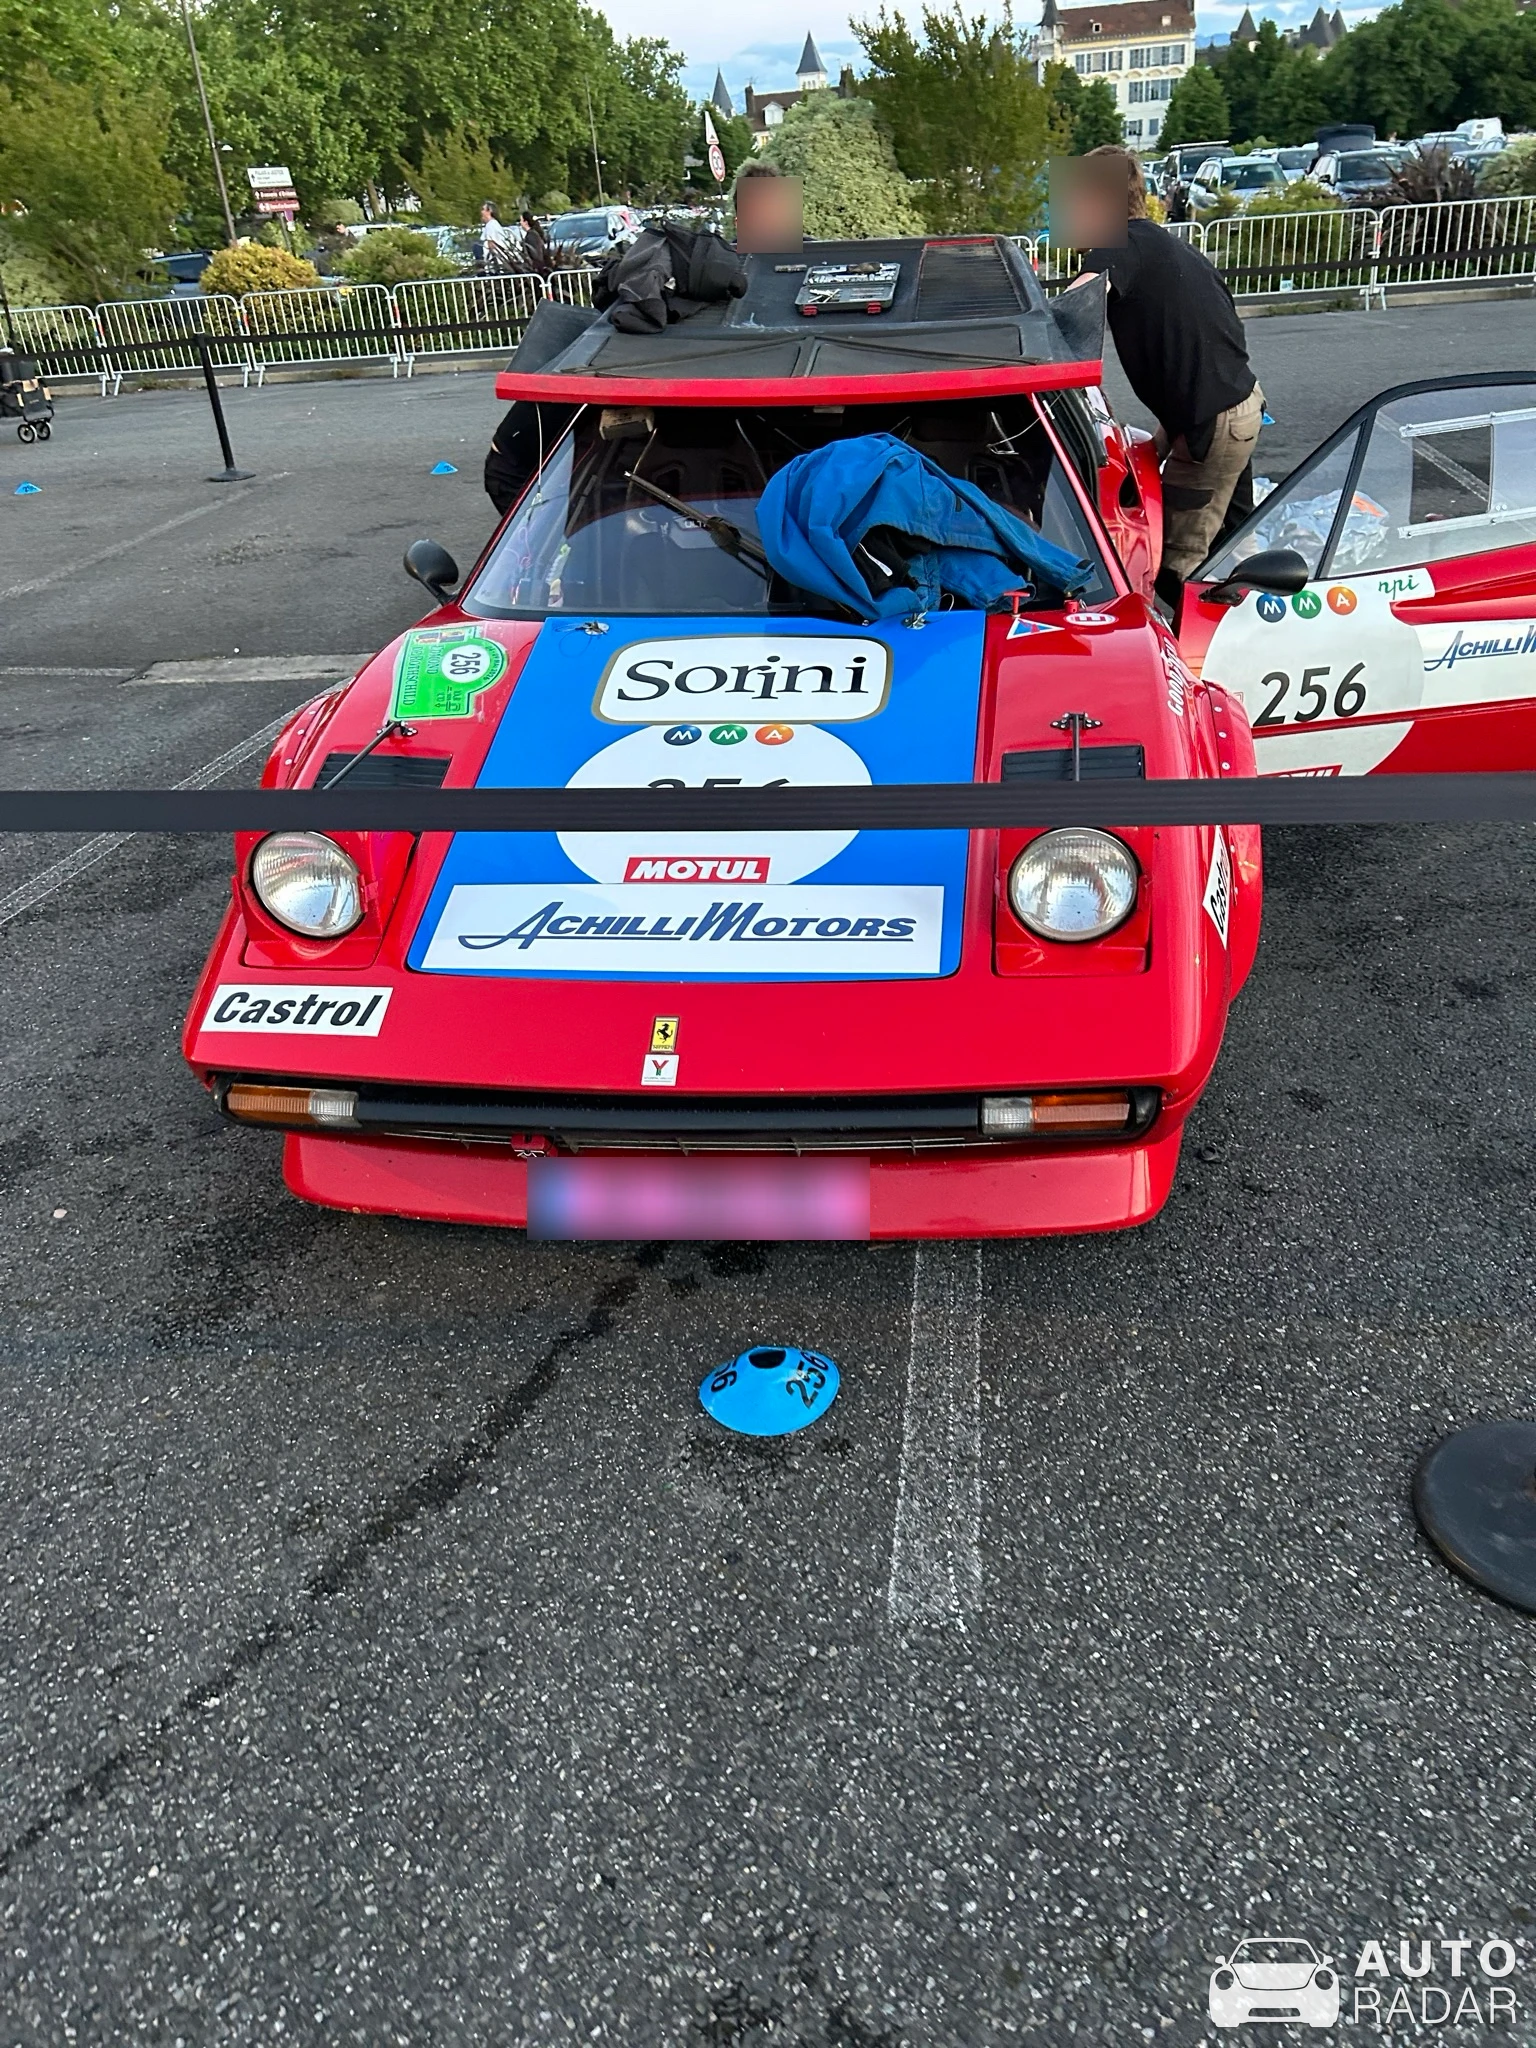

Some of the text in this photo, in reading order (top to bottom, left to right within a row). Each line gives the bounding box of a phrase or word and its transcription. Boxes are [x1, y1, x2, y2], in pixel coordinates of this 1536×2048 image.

[1378, 575, 1419, 600] npi
[426, 644, 445, 675] EDMOND
[450, 652, 482, 675] 256
[402, 654, 423, 706] ROTHSCHILD
[617, 655, 870, 702] Sorini
[1253, 662, 1367, 727] 256
[629, 859, 763, 881] MOTUL
[213, 991, 384, 1027] Castrol
[785, 1351, 829, 1410] 256
